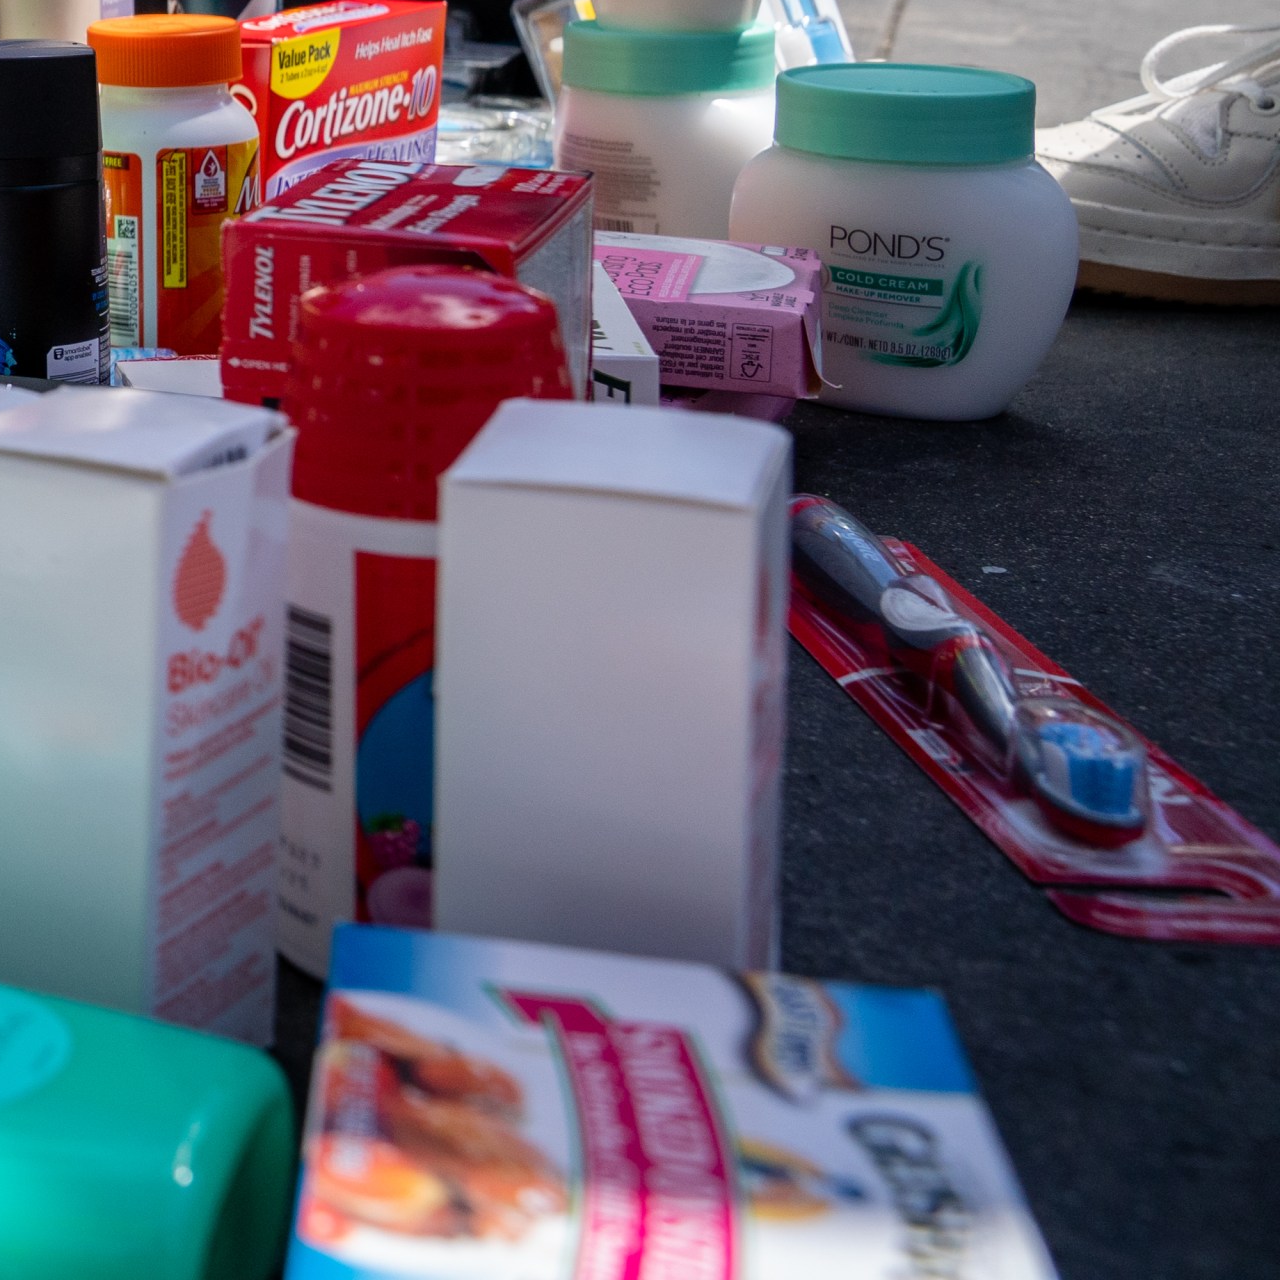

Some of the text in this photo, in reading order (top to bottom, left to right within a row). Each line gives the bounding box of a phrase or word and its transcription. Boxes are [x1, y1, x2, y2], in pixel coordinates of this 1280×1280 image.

[355, 42, 380, 60] Helps
[381, 36, 400, 53] Heal
[417, 26, 433, 42] Fast
[279, 41, 331, 70] Value Pack
[105, 158, 123, 167] FREE
[830, 225, 946, 262] POND'S
[836, 271, 929, 292] COLD CREAM
[249, 245, 276, 341] TYLENOL
[836, 285, 921, 303] MAKE-UP REMOVER
[692, 345, 726, 356] GARNIER
[868, 339, 889, 353] NETO
